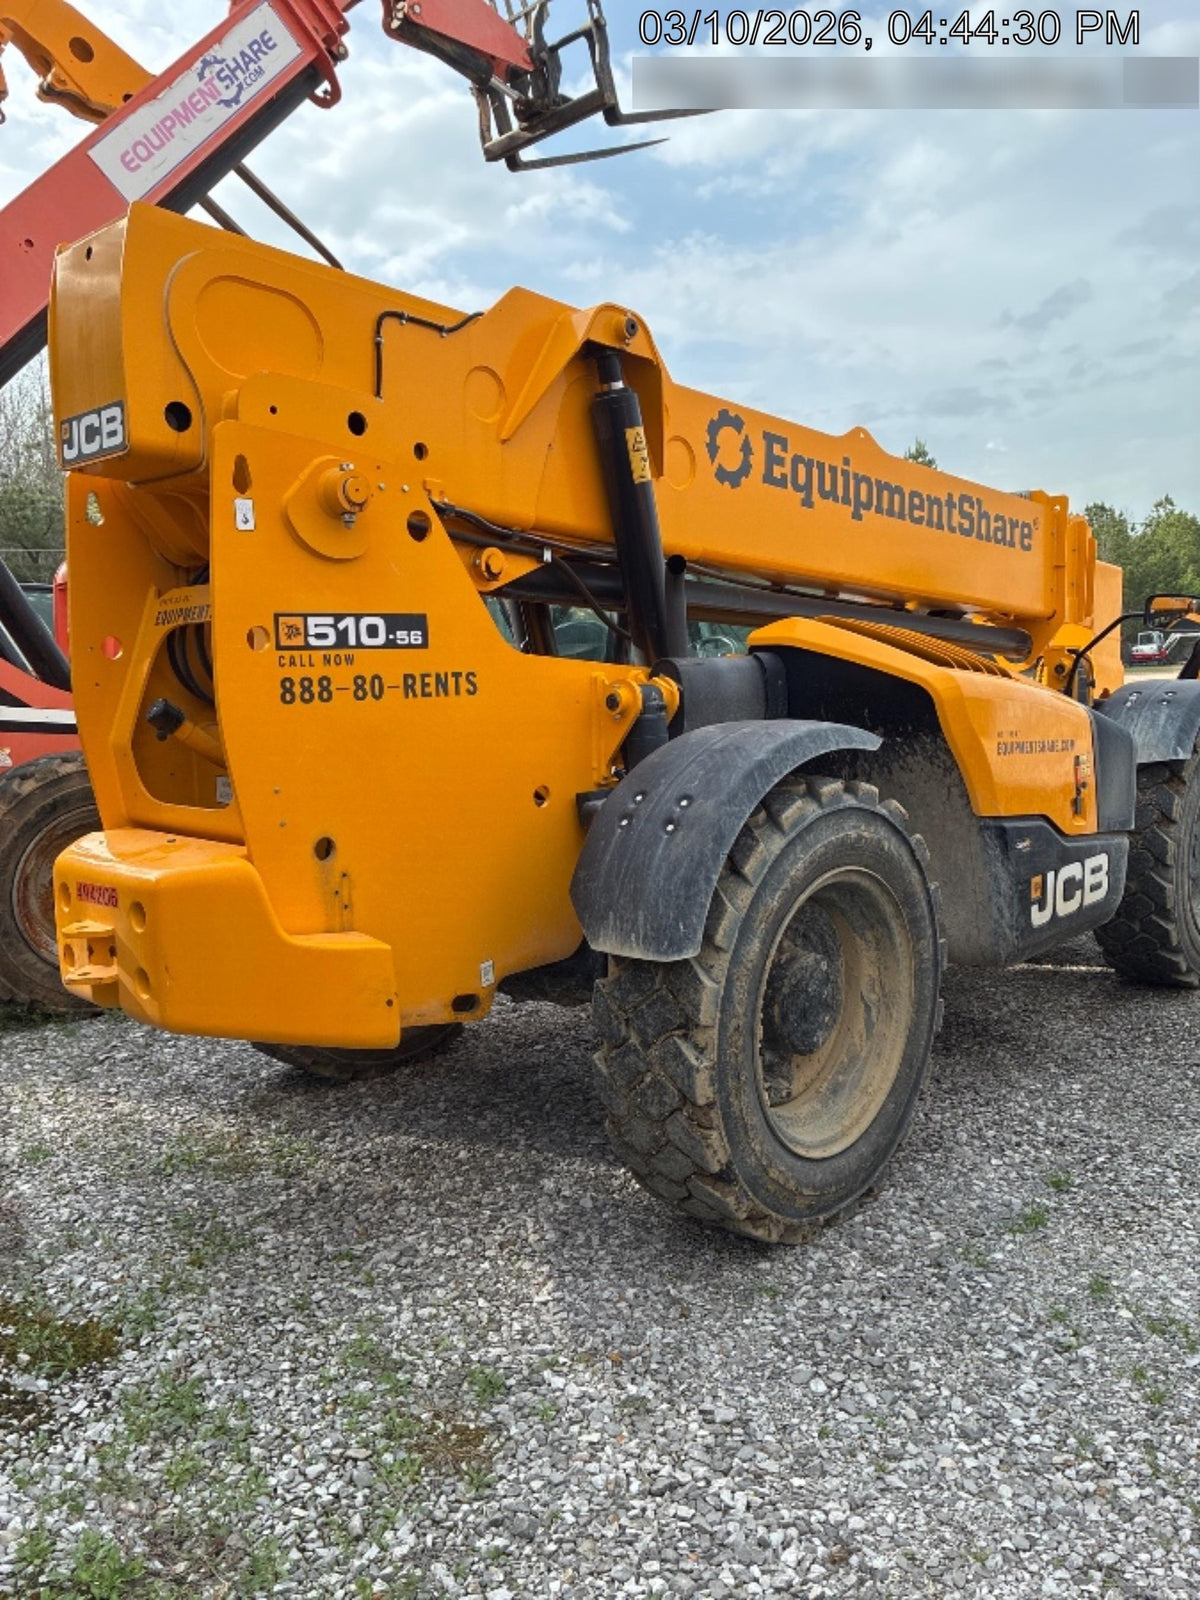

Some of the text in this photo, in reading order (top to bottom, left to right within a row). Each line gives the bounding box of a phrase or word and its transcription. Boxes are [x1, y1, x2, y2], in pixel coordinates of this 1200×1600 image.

[63, 406, 123, 460] JCB
[762, 430, 1032, 552] EquipmentShare
[154, 604, 212, 627] EQUIPMENT
[278, 654, 355, 668] CALL NOW
[279, 671, 478, 705] 888-80-RENTS
[1030, 852, 1109, 929] JCB
